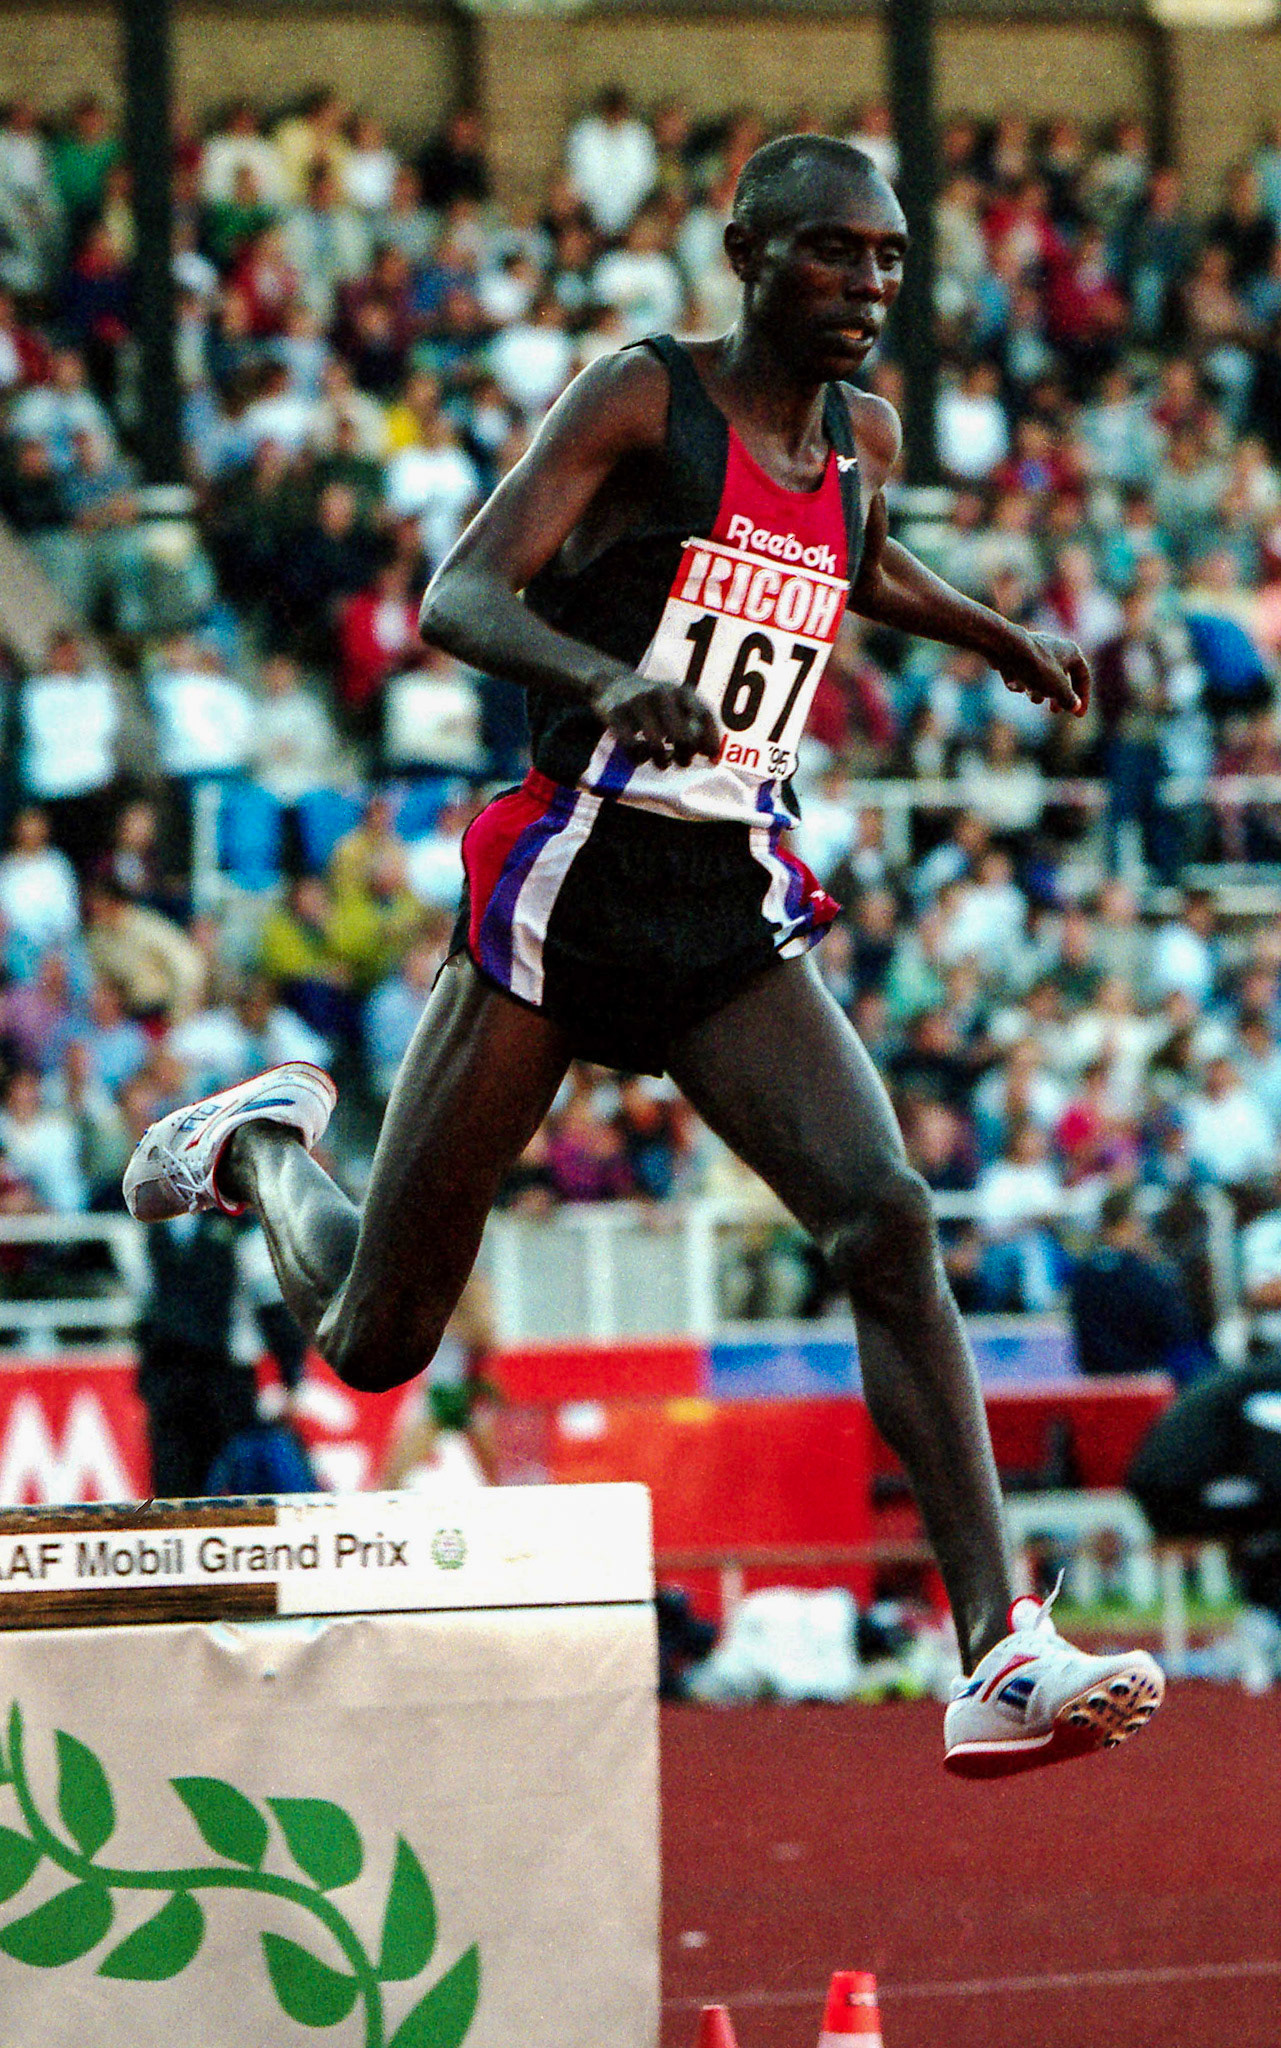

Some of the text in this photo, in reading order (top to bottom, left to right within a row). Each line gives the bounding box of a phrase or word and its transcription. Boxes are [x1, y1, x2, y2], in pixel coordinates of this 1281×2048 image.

[727, 513, 837, 574] Reebok
[680, 550, 842, 639] RICOH
[684, 613, 819, 743] 167
[0, 1542, 63, 1581] AF
[75, 1537, 185, 1578] Mobil
[200, 1535, 320, 1575] Grand
[335, 1531, 409, 1569] Prix
